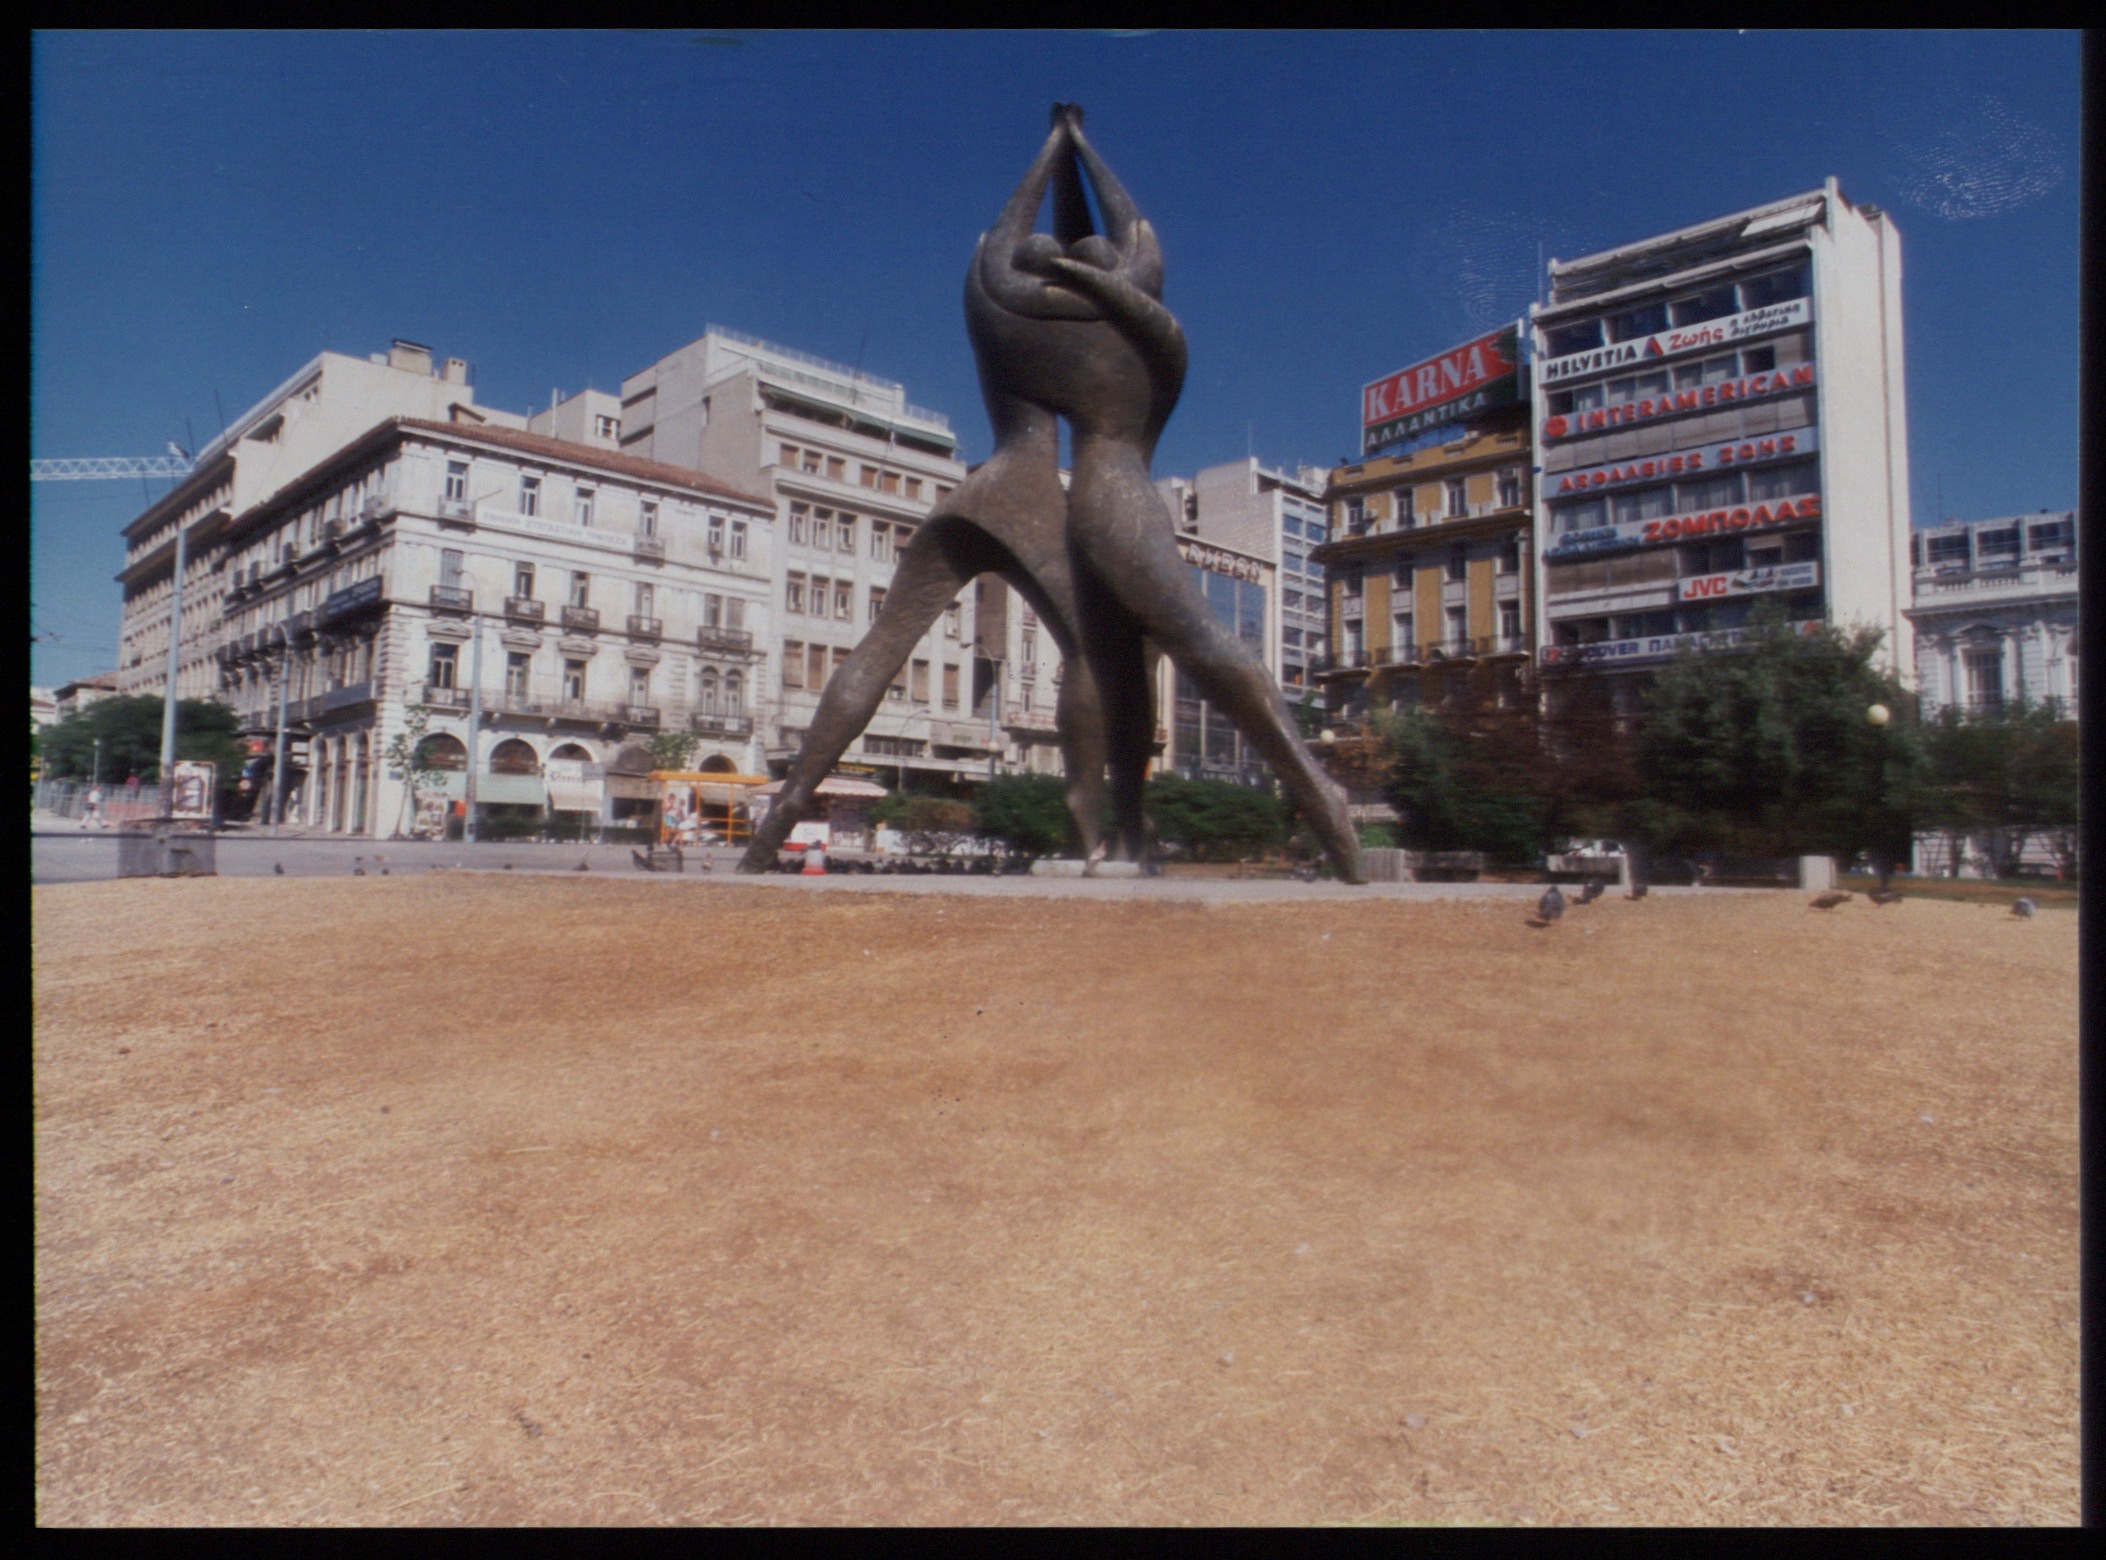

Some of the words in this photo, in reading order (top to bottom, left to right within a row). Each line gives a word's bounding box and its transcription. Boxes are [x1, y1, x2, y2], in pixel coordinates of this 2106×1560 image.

[1367, 345, 1488, 422] KARNA
[1546, 345, 1637, 379] HELVETIA
[1367, 393, 1487, 448] ΑΛΛΑΝΤΙΚΑ
[1577, 364, 1813, 431] INTERAMERICAN
[1560, 451, 1703, 492] ΑΣΦΑΛΕΙΕΣ
[1719, 435, 1796, 463] ΖΩΗΣ
[1642, 495, 1821, 542] ΖΟΜΠΟΛΑΣ
[1683, 576, 1727, 599] JVC
